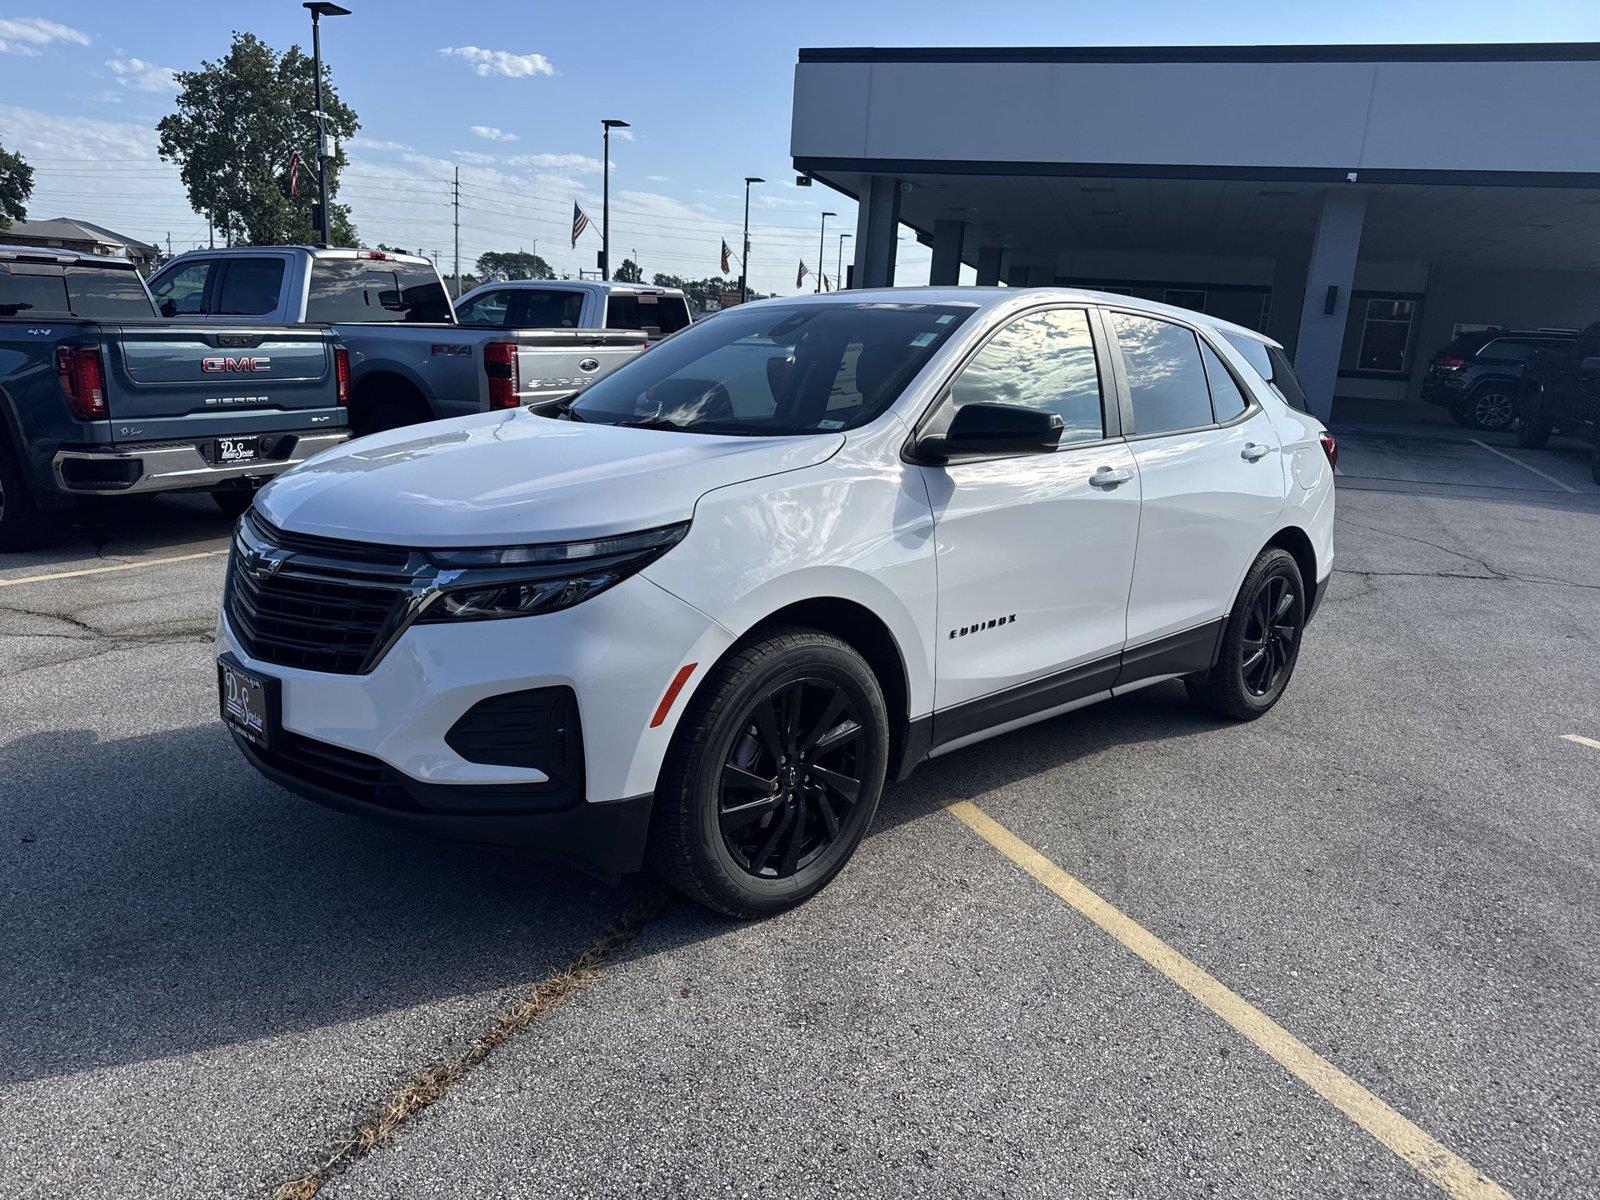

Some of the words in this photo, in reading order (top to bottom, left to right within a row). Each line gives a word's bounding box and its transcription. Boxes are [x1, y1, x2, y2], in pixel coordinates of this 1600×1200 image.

[431, 343, 472, 357] FX4
[202, 357, 271, 373] GMC
[528, 377, 593, 388] SUPER
[205, 396, 269, 405] SIERRA
[948, 613, 1016, 640] EQUINOX
